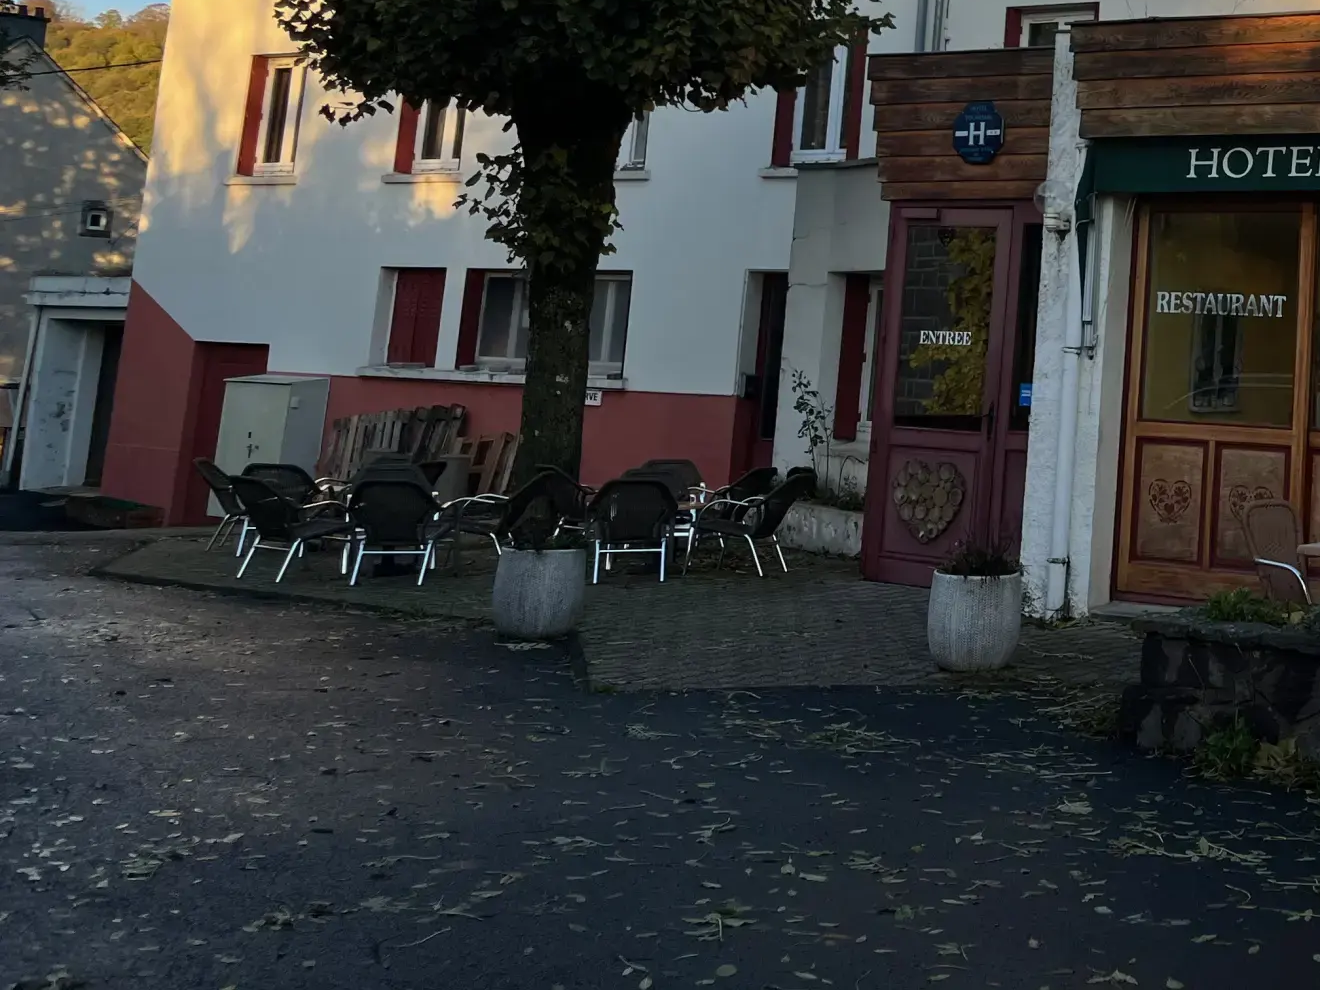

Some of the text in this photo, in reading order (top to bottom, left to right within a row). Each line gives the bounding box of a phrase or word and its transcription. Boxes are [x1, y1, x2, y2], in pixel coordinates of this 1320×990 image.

[968, 121, 985, 146] H
[1156, 291, 1287, 318] RESTAURANT
[919, 330, 972, 346] ENTREE
